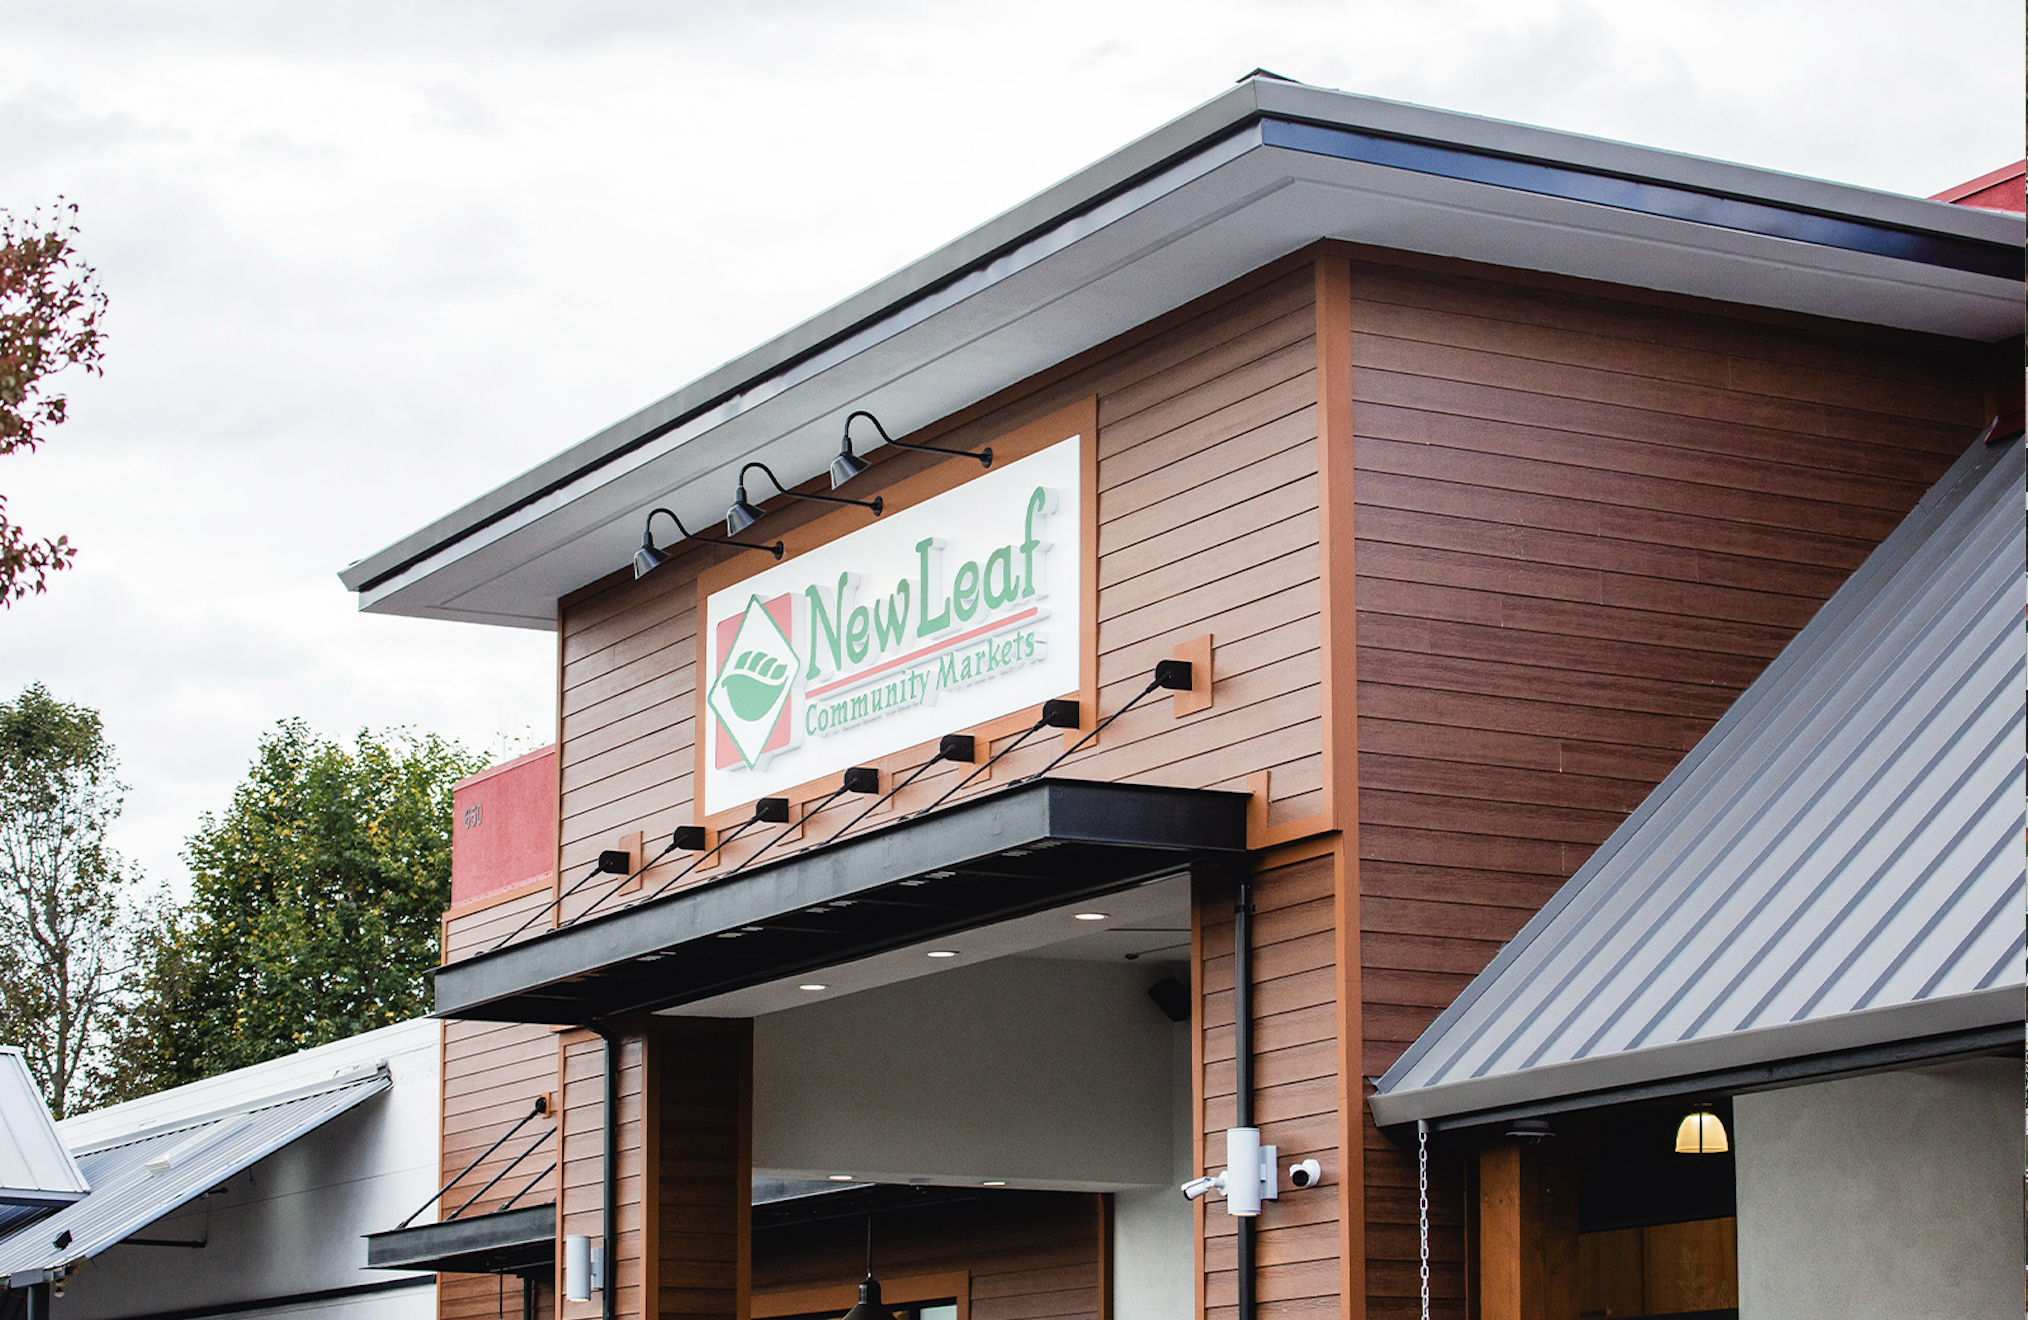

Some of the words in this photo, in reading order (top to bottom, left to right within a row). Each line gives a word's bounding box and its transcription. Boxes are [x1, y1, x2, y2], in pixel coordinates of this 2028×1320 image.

[805, 669, 931, 736] Community
[935, 630, 1035, 691] Markets
[463, 803, 483, 829] 650
